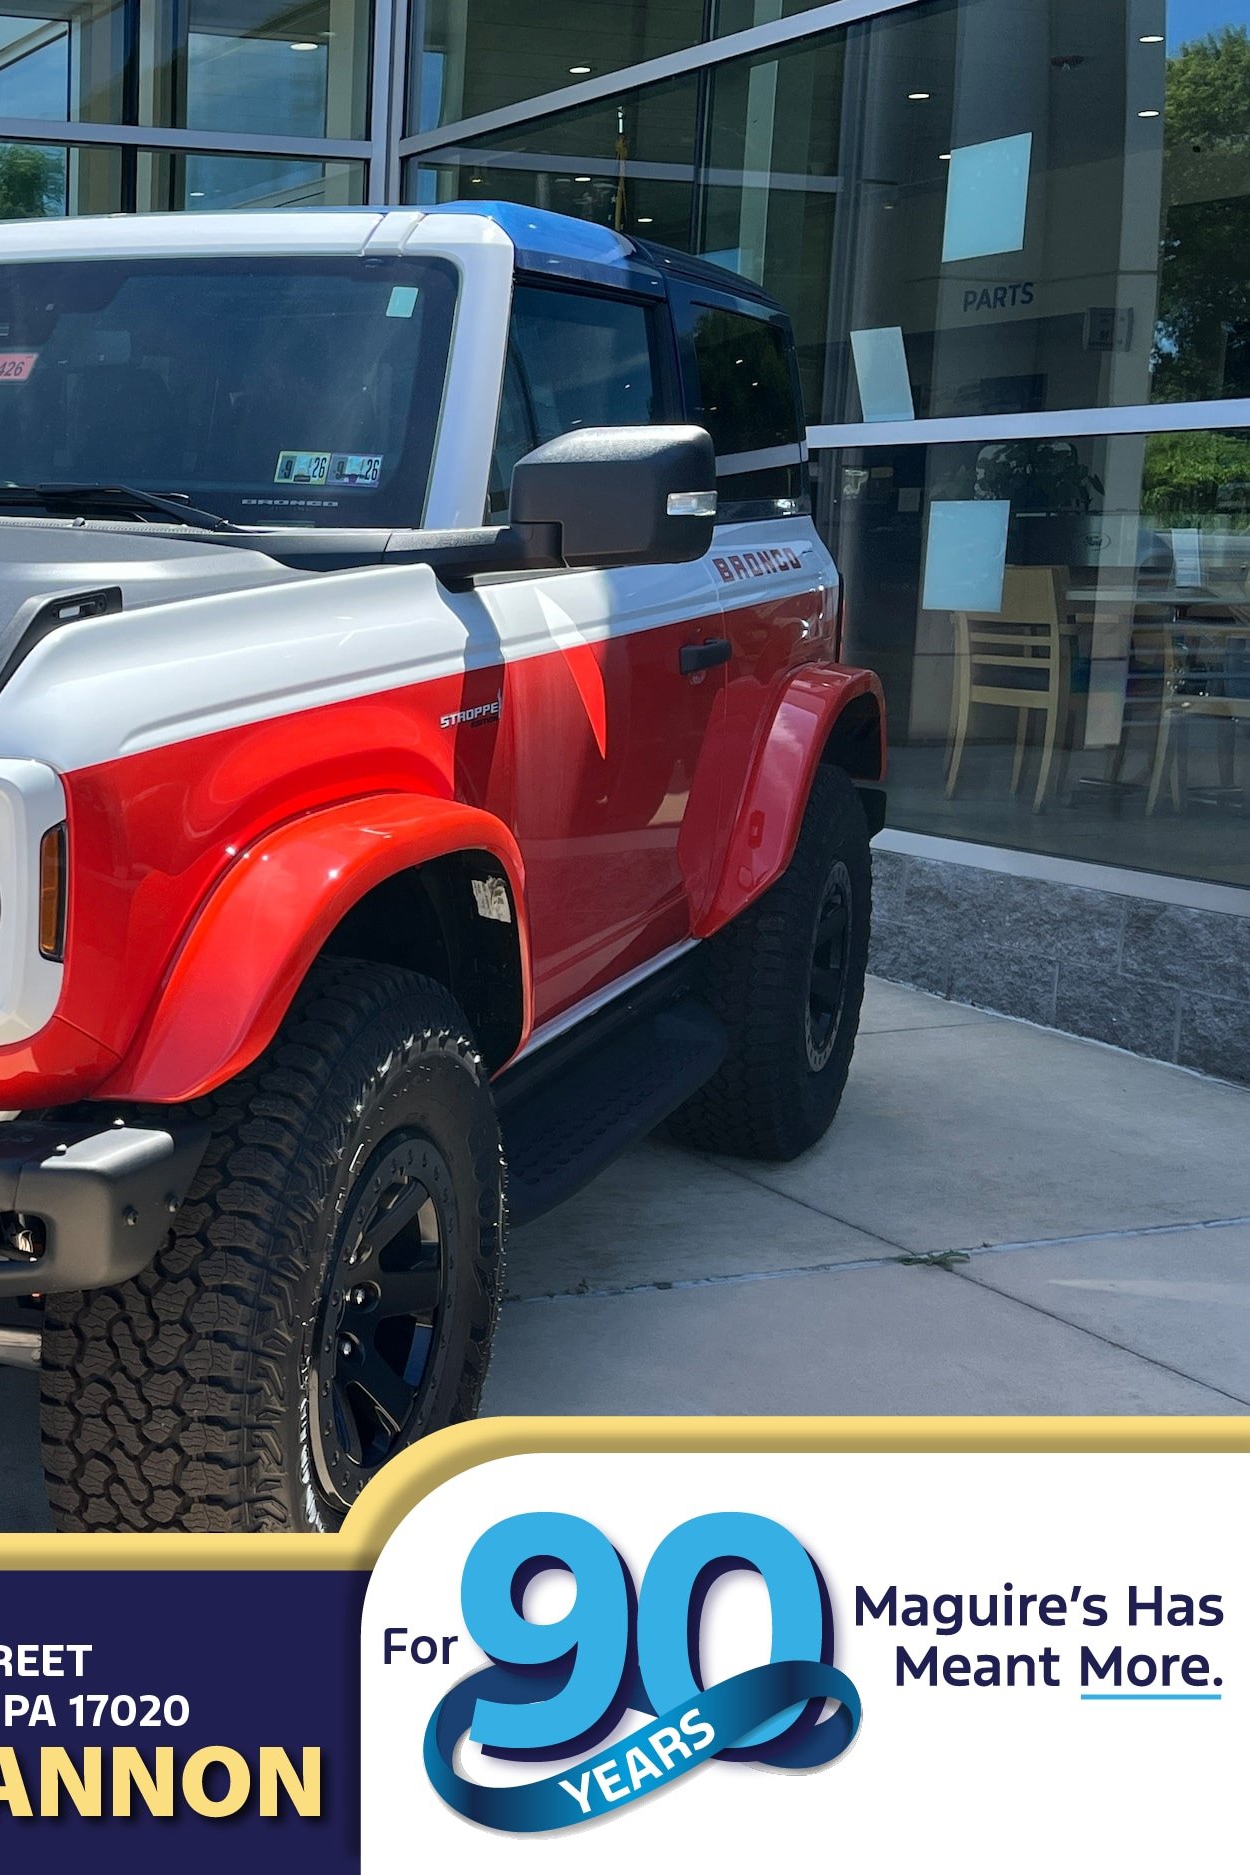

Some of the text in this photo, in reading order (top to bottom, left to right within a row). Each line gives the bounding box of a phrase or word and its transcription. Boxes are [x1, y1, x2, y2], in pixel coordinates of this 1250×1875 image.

[963, 282, 1035, 313] PARTS
[311, 456, 327, 479] 26
[364, 459, 380, 481] 26
[241, 499, 339, 507] BRONCO
[712, 547, 802, 583] BRONCO
[440, 701, 499, 729] STROPPE
